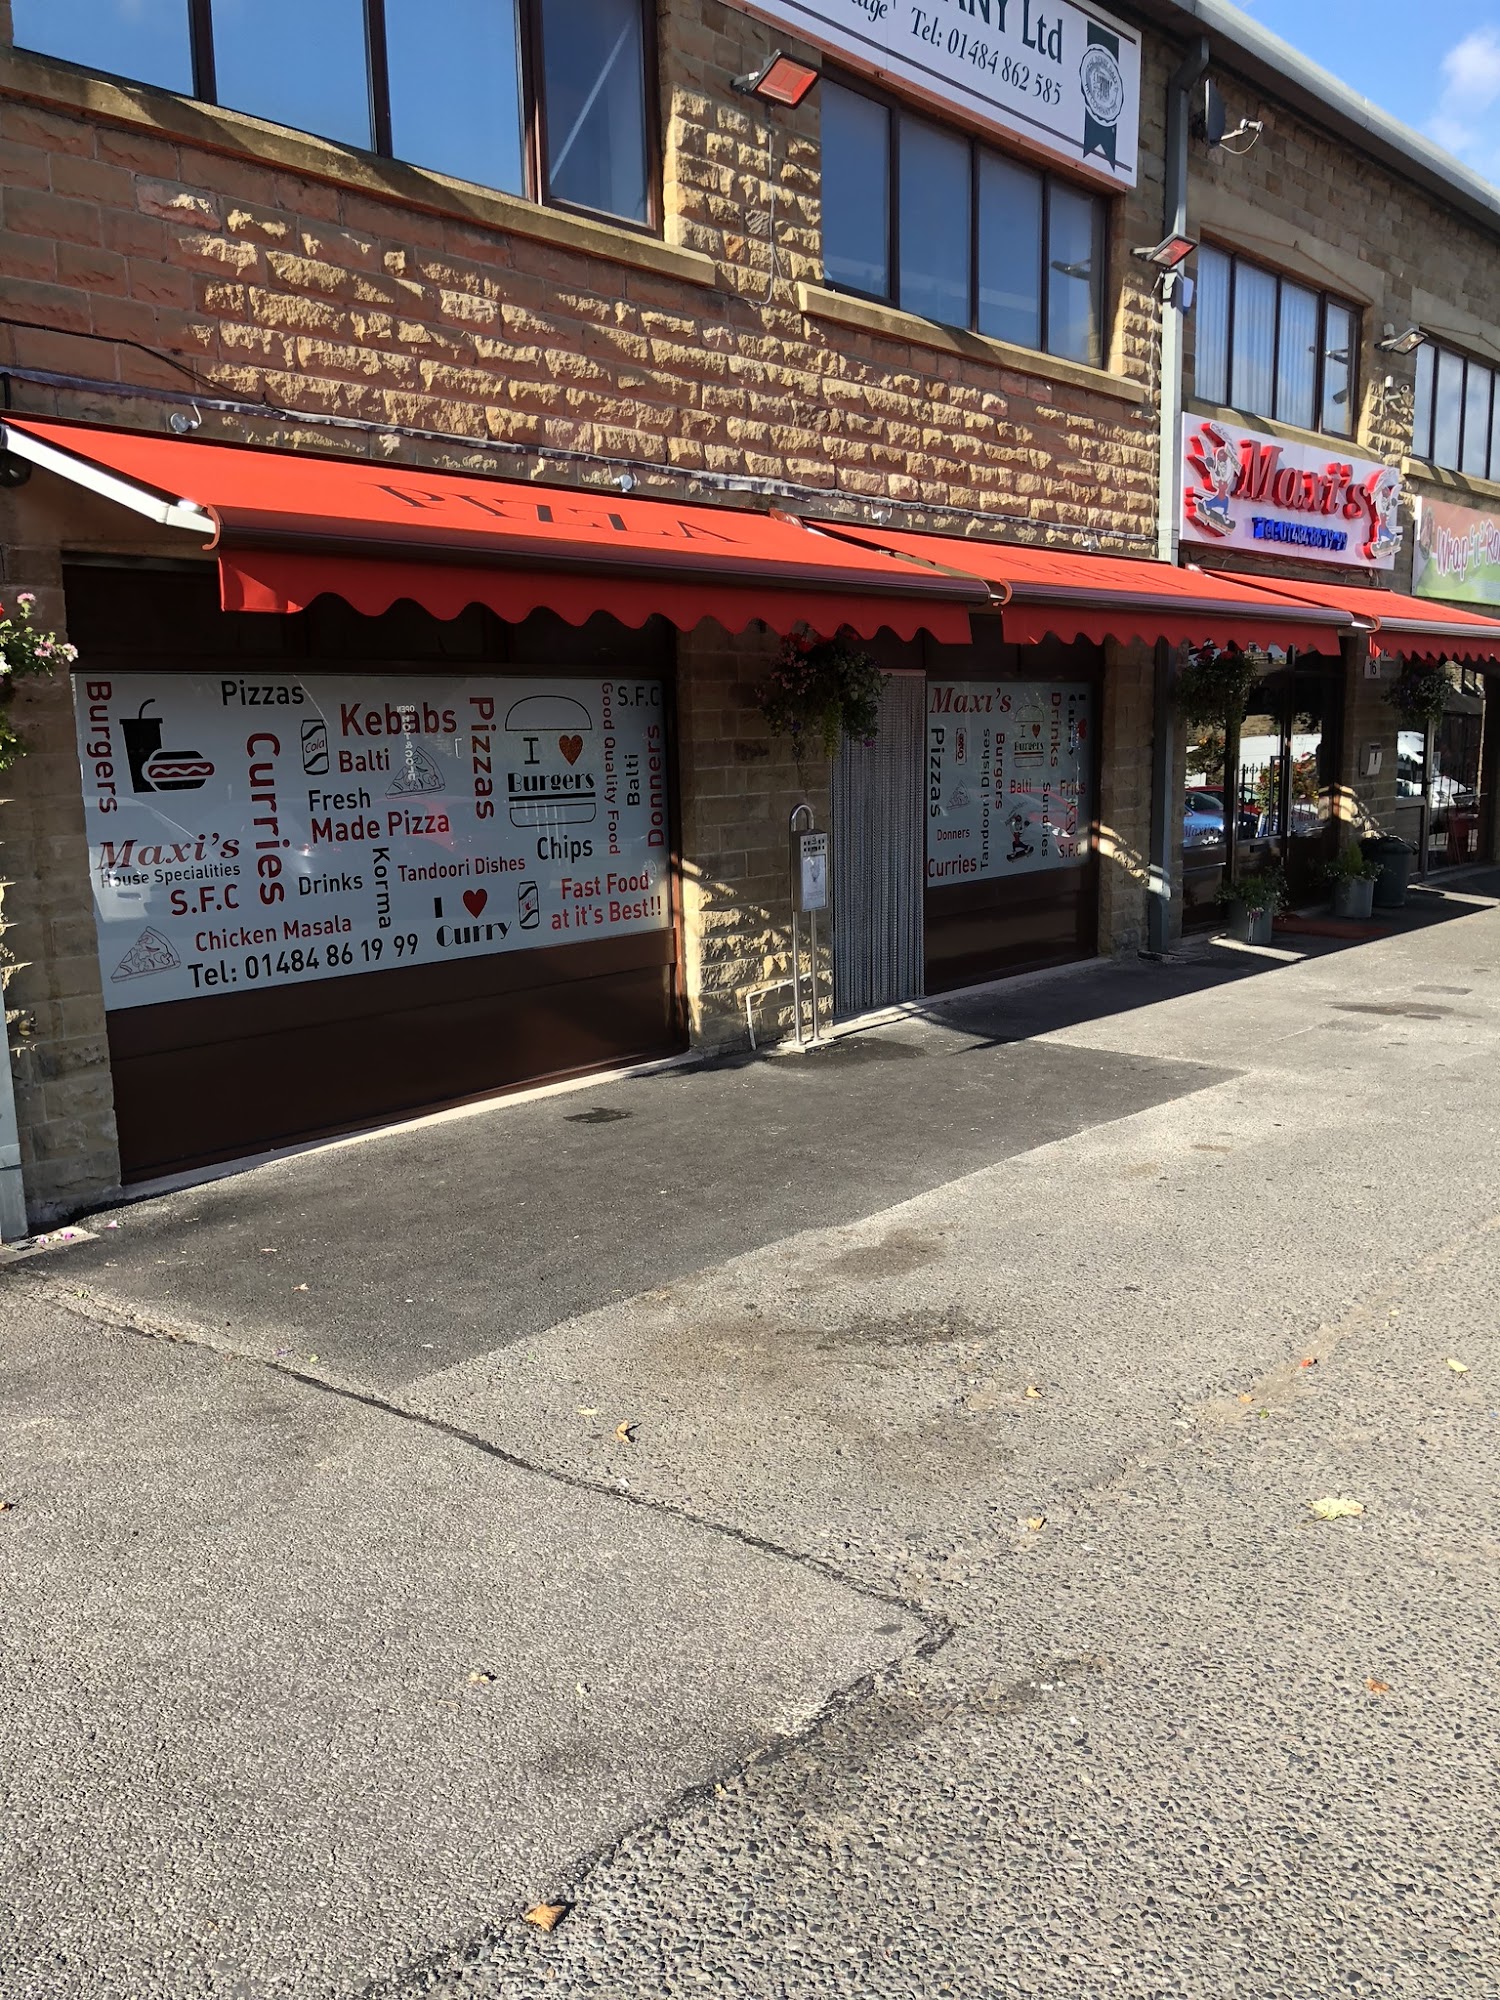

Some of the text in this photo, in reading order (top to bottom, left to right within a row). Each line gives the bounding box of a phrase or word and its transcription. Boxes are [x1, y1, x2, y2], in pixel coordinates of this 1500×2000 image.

[1022, 0, 1063, 64] Ltd
[911, 7, 942, 47] Tel:
[947, 28, 999, 75] 01484
[1001, 56, 1030, 91] 862
[1032, 73, 1063, 105] 585
[1233, 440, 1369, 520] Maxi's
[358, 481, 752, 545] PIZZA
[1436, 526, 1468, 581] Wrap
[1369, 662, 1377, 675] 16
[220, 680, 305, 706] Pizzas
[617, 685, 661, 707] S.F.C
[340, 702, 458, 736] Kebabs
[1050, 692, 1062, 768] Drinks
[85, 681, 118, 814] Burgers
[305, 738, 325, 755] Cola
[339, 748, 391, 774] Balti
[469, 696, 497, 820] Pizzas
[523, 737, 541, 765] I
[1014, 741, 1044, 751] Burgers
[507, 771, 596, 794] Burgers
[601, 682, 621, 855] Good Quality Food
[625, 753, 642, 807] Balti
[930, 728, 945, 818] Pizzas
[993, 732, 1005, 810] Burgers
[1009, 778, 1032, 794] Balti
[308, 787, 372, 812] Fresh
[647, 725, 665, 848] Donners
[980, 728, 991, 871] Tandoori Dishes
[246, 732, 291, 904] Curries
[311, 809, 450, 844] Made Pizza
[937, 827, 971, 841] Donners
[1042, 782, 1051, 857] Sundries
[95, 832, 241, 871] Maxi's
[536, 834, 594, 864] Chips
[928, 854, 977, 878] Curries
[100, 863, 241, 889] House Specialities
[299, 872, 364, 896] Drinks
[397, 855, 526, 883] Tandoori Dishes
[560, 871, 649, 901] Fast Food
[169, 884, 240, 916] S.F.C
[372, 847, 392, 929] Korma
[433, 896, 444, 919] I
[551, 895, 662, 930] at it's Best!!
[194, 916, 352, 953] Chicken Masala
[435, 919, 513, 948] Curry
[187, 932, 419, 989] Tel: 01484 86 19 99
